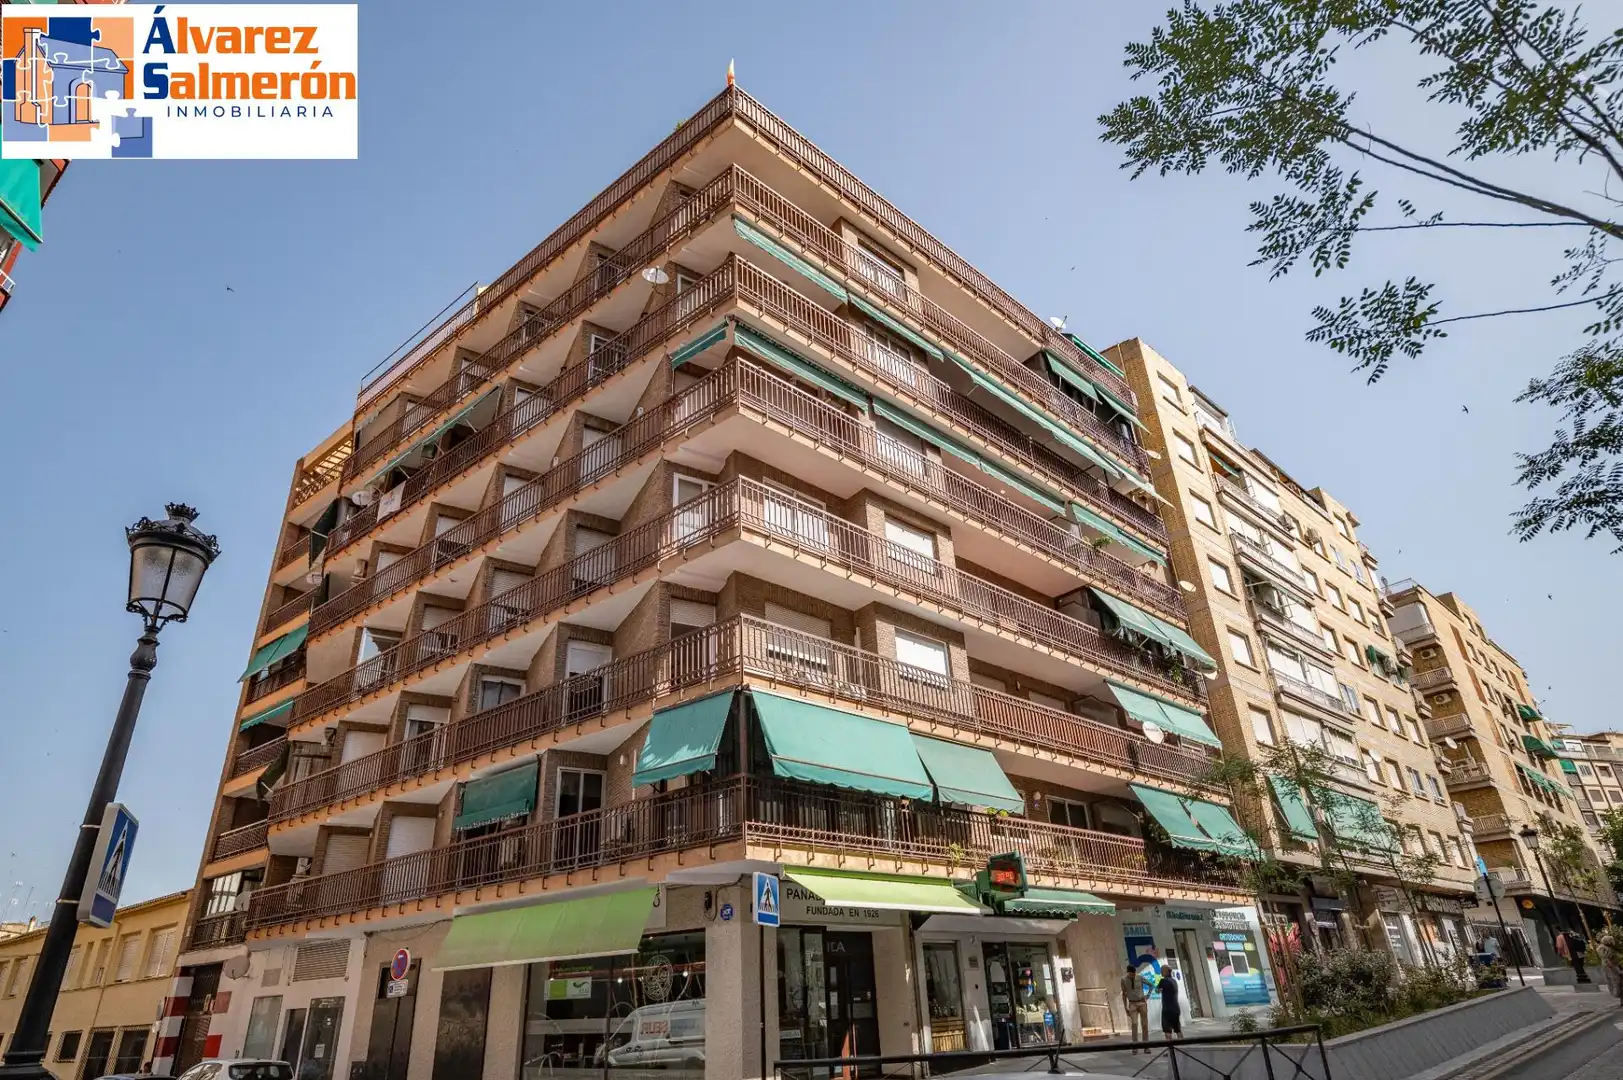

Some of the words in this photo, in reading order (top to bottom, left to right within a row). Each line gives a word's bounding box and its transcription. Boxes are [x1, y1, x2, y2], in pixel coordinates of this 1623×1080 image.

[807, 906, 845, 917] FUNDADA
[849, 908, 860, 917] EN
[863, 909, 880, 918] 1926
